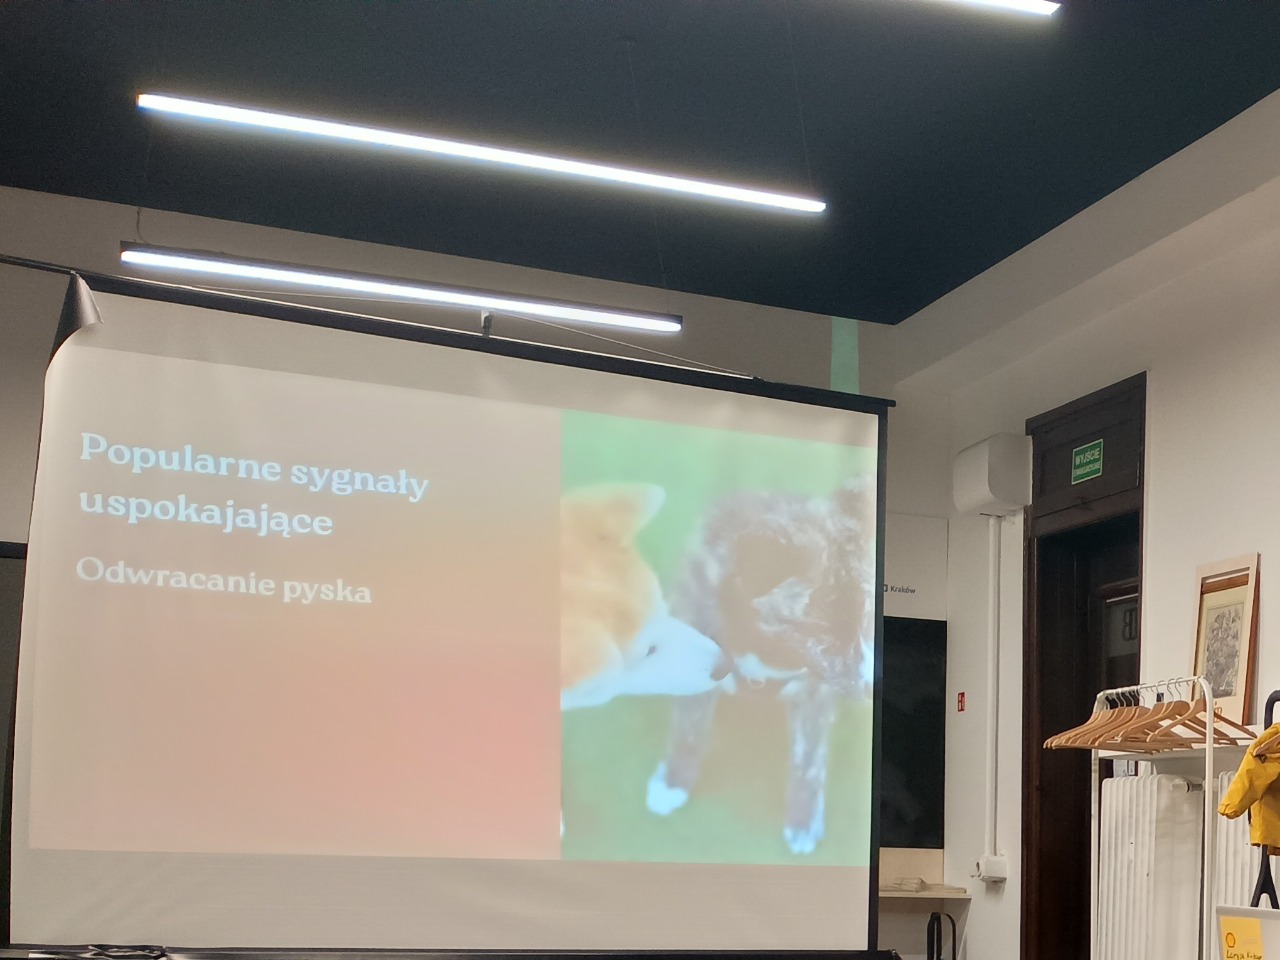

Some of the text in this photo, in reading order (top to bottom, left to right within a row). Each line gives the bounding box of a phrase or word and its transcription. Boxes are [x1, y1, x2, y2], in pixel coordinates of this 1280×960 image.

[79, 432, 430, 503] Popularne sygnały
[79, 491, 334, 538] uspokajające
[76, 556, 372, 604] Odwracanie pyska
[890, 585, 916, 594] Kraków
